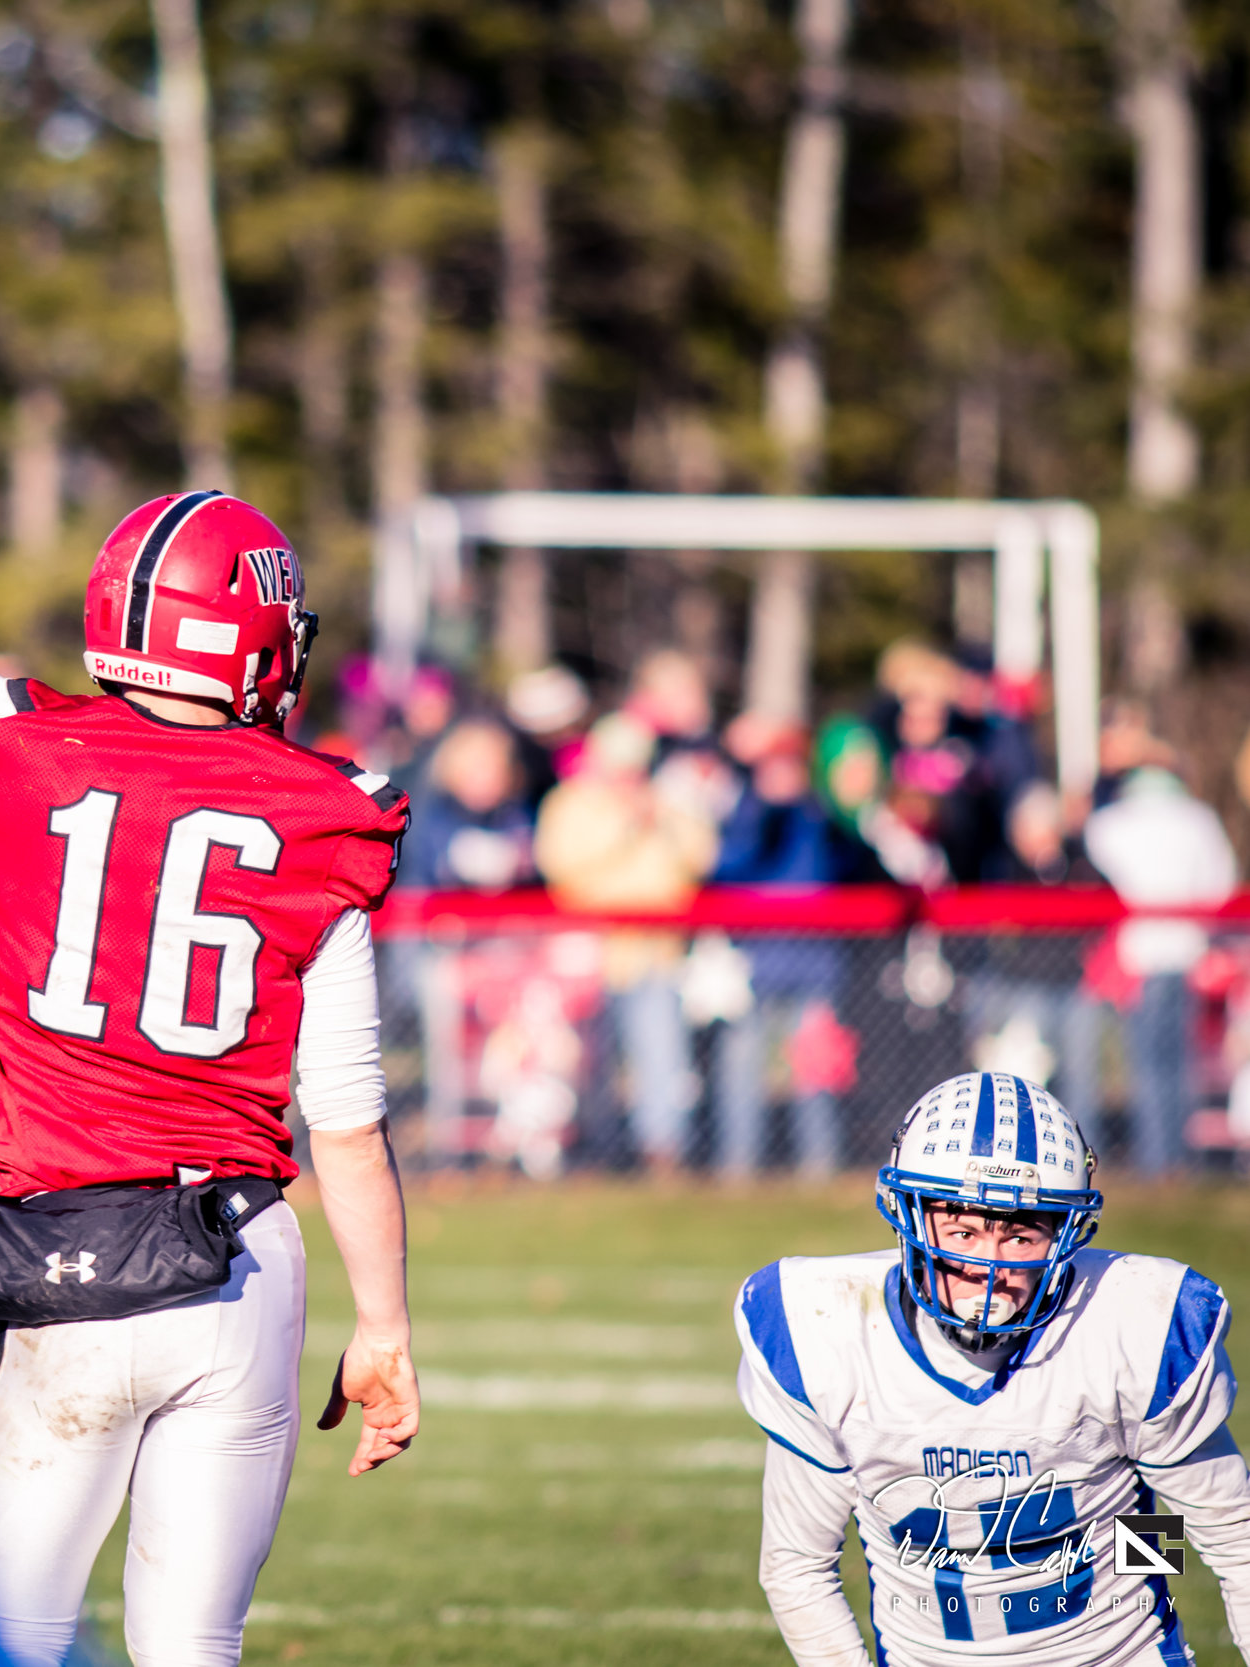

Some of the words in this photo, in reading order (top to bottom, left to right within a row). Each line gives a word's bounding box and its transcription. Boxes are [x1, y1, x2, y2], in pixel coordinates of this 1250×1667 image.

[94, 657, 171, 687] Riddell
[26, 786, 286, 1060] 16
[980, 1164, 1022, 1177] schutt
[922, 1446, 1033, 1479] MADISON
